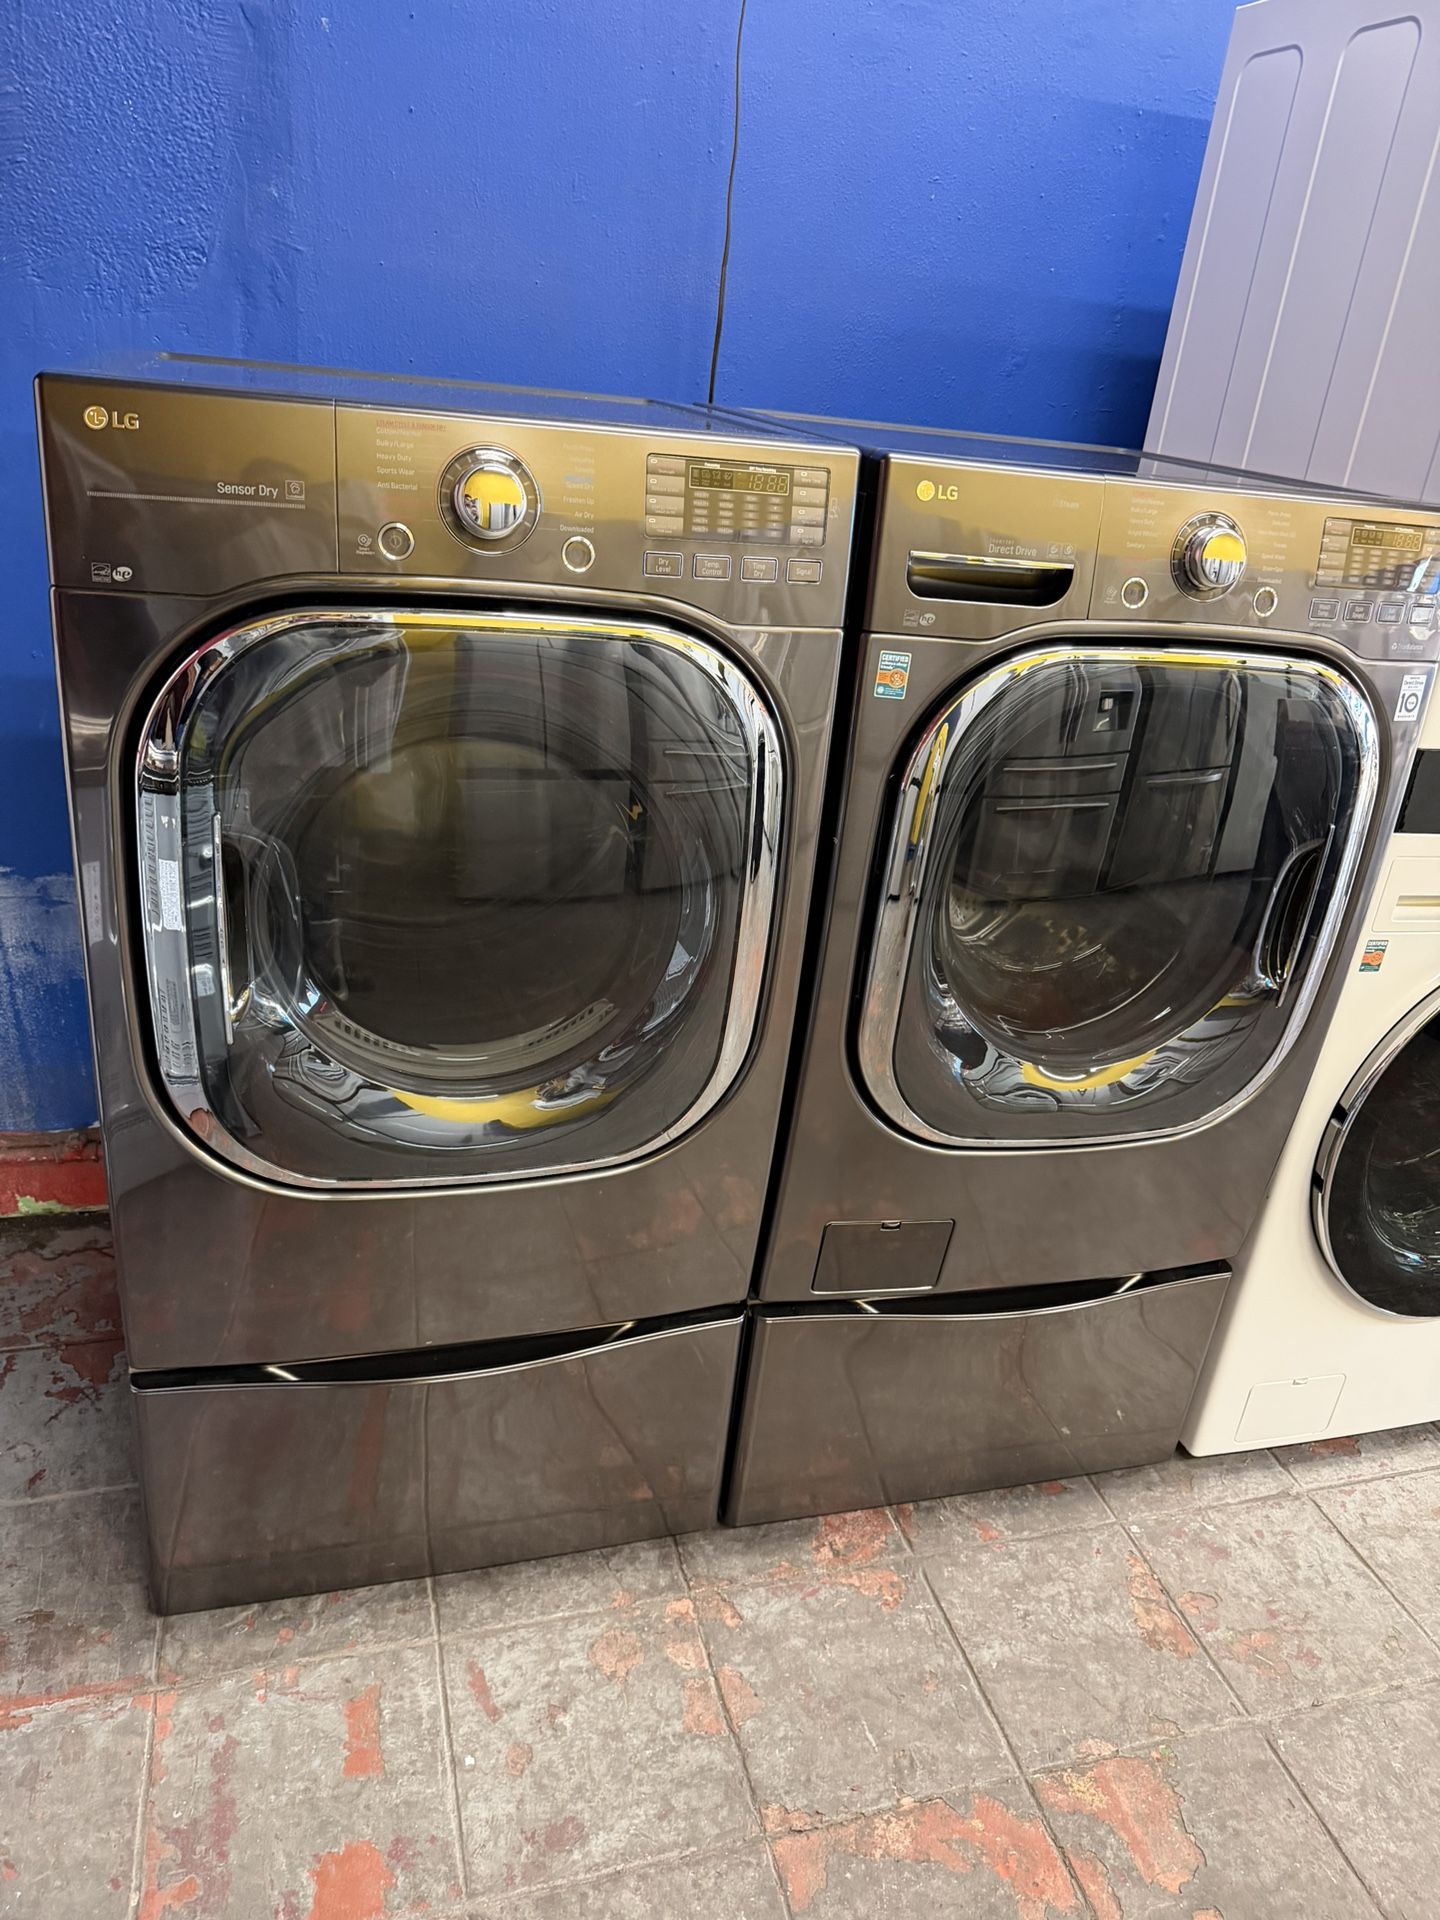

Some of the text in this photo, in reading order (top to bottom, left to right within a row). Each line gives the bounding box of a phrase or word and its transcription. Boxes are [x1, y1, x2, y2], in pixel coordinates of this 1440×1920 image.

[112, 411, 140, 430] LG
[397, 453, 412, 462] Duty
[217, 481, 279, 499] Sensor Dry
[937, 484, 959, 501] LG
[584, 511, 595, 520] Dry
[988, 543, 1038, 557] Direct Drive
[658, 557, 670, 566] Dry
[655, 564, 672, 573] Level
[701, 567, 723, 576] Control
[753, 563, 766, 571] Time
[754, 569, 764, 578] Dry
[796, 567, 814, 577] Signal
[1399, 692, 1420, 713] 10
